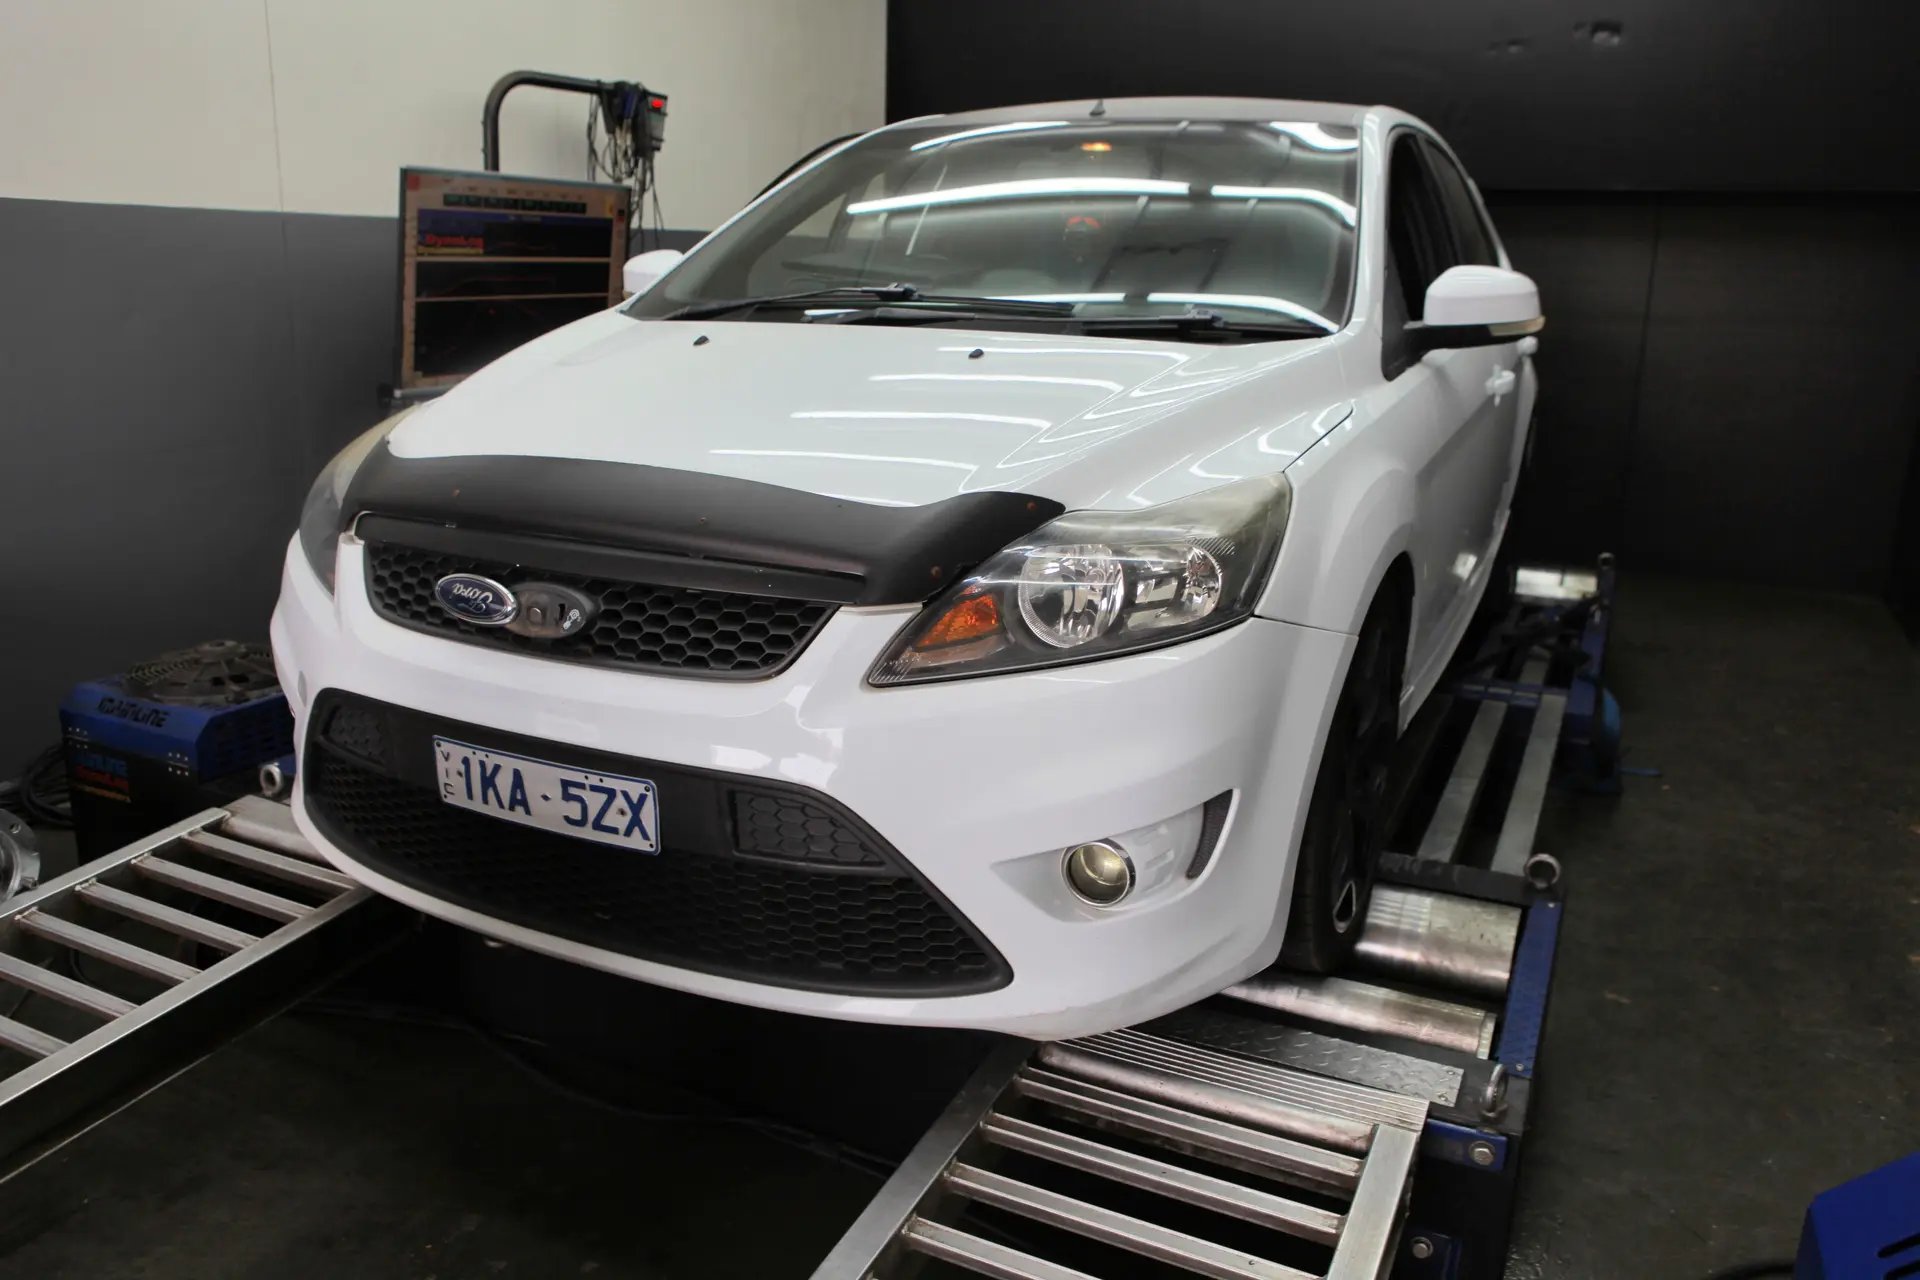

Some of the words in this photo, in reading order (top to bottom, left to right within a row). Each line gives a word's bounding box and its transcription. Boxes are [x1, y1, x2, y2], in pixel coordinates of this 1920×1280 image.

[450, 583, 494, 614] Ford
[440, 750, 456, 796] VIC
[461, 756, 532, 816] 1KA
[559, 778, 651, 841] 5ZX
